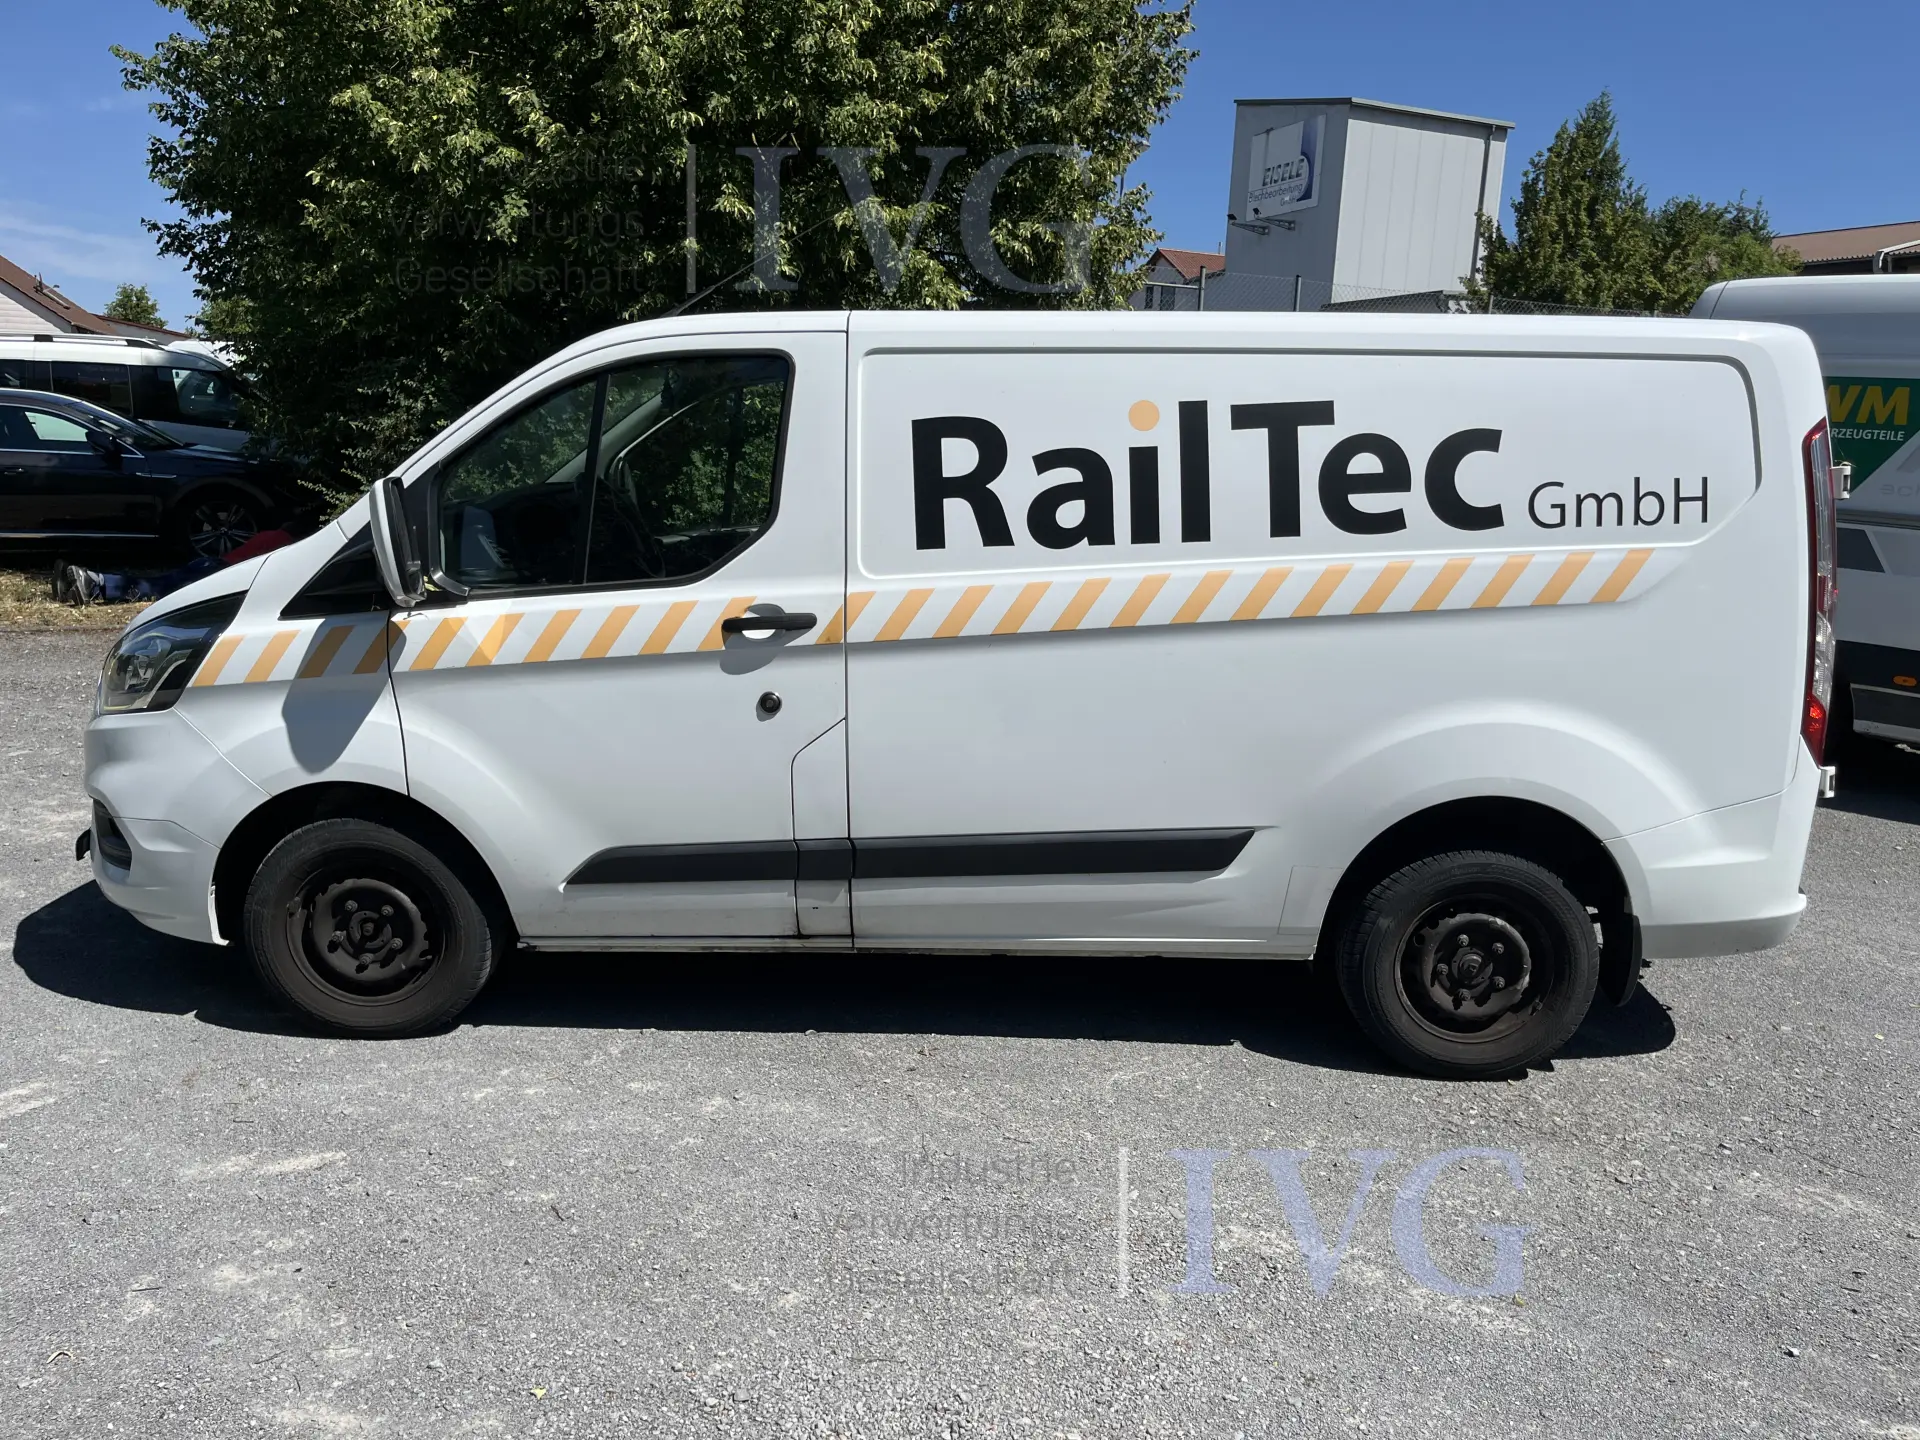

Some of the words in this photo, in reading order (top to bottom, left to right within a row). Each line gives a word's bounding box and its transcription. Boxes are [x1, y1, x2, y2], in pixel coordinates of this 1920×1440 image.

[1262, 158, 1305, 187] EISELE
[1830, 428, 1906, 441] RZEUGTEILE
[911, 399, 1505, 550] RailTec
[1527, 476, 1709, 531] GmbH
